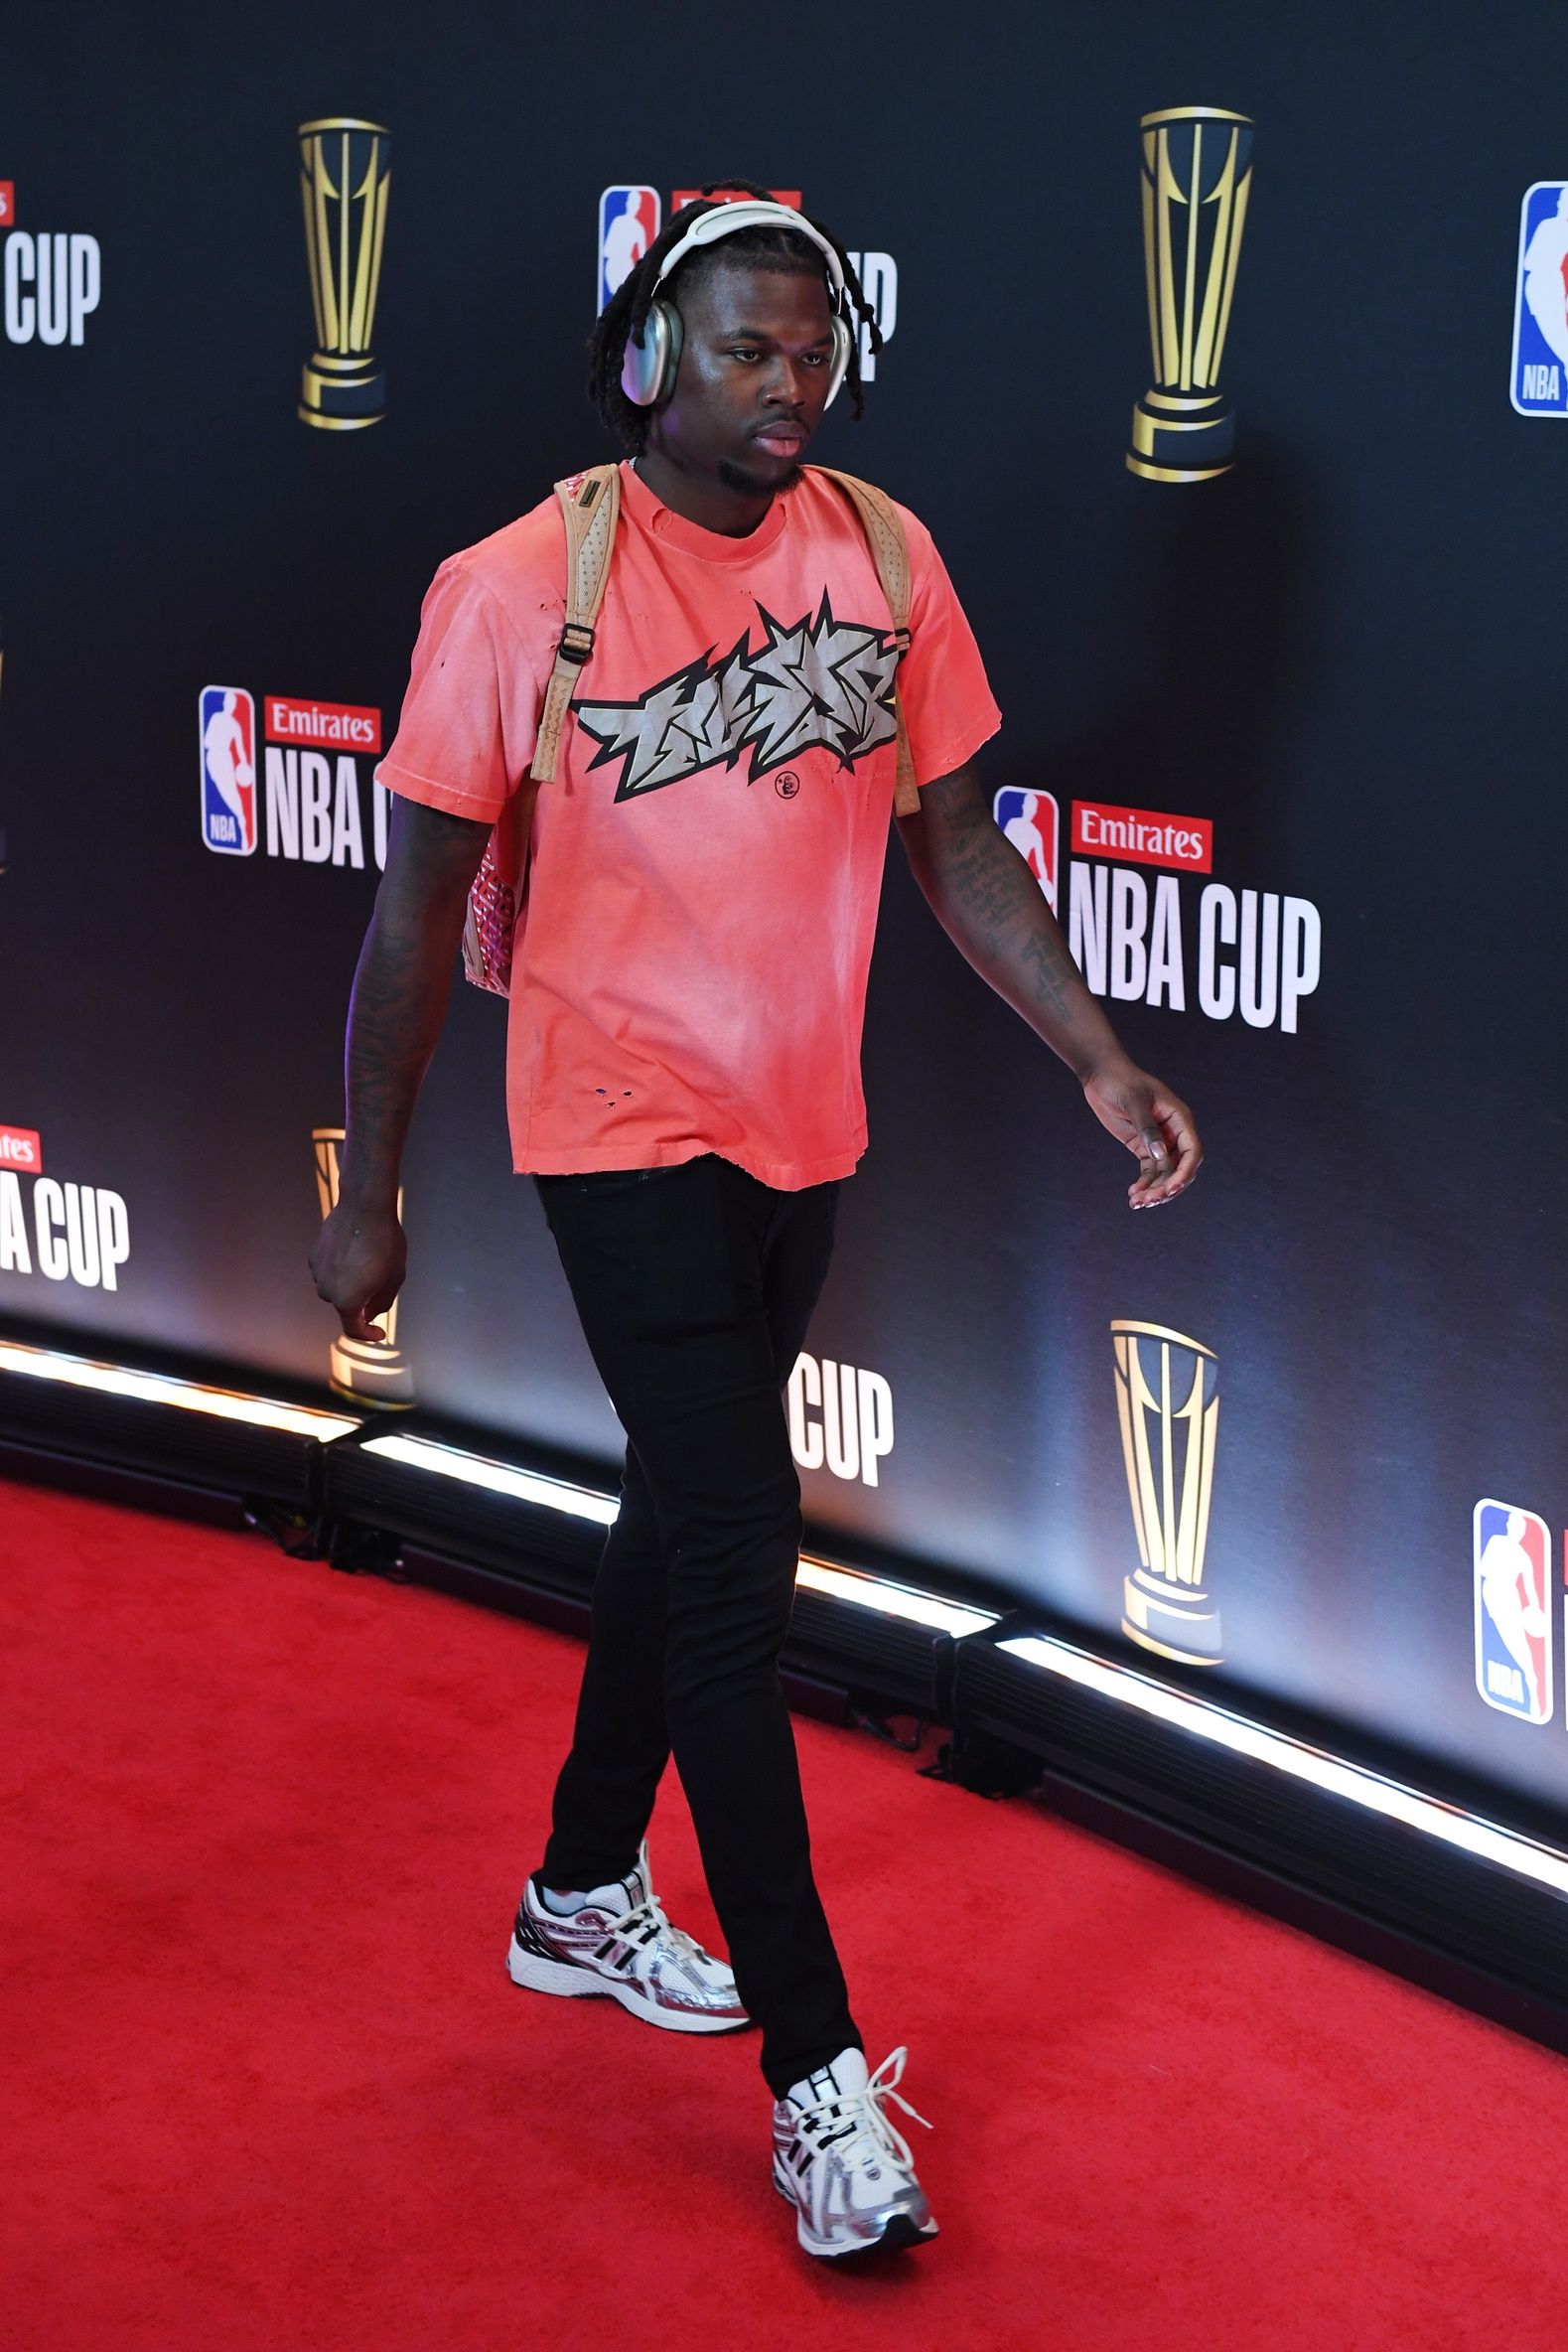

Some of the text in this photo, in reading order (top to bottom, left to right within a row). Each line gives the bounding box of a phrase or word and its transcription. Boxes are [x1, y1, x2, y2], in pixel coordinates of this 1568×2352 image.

[4, 230, 100, 346] CUP
[1522, 364, 1560, 401] NBA
[272, 703, 374, 743] Emirates
[210, 814, 237, 843] NBA
[265, 746, 364, 869] NBA
[1080, 808, 1204, 859] Emirates
[1069, 860, 1322, 1034] NBA CUP
[33, 1177, 130, 1291] CUP
[787, 1352, 894, 1487] CUP
[1488, 1660, 1525, 1703] NBA
